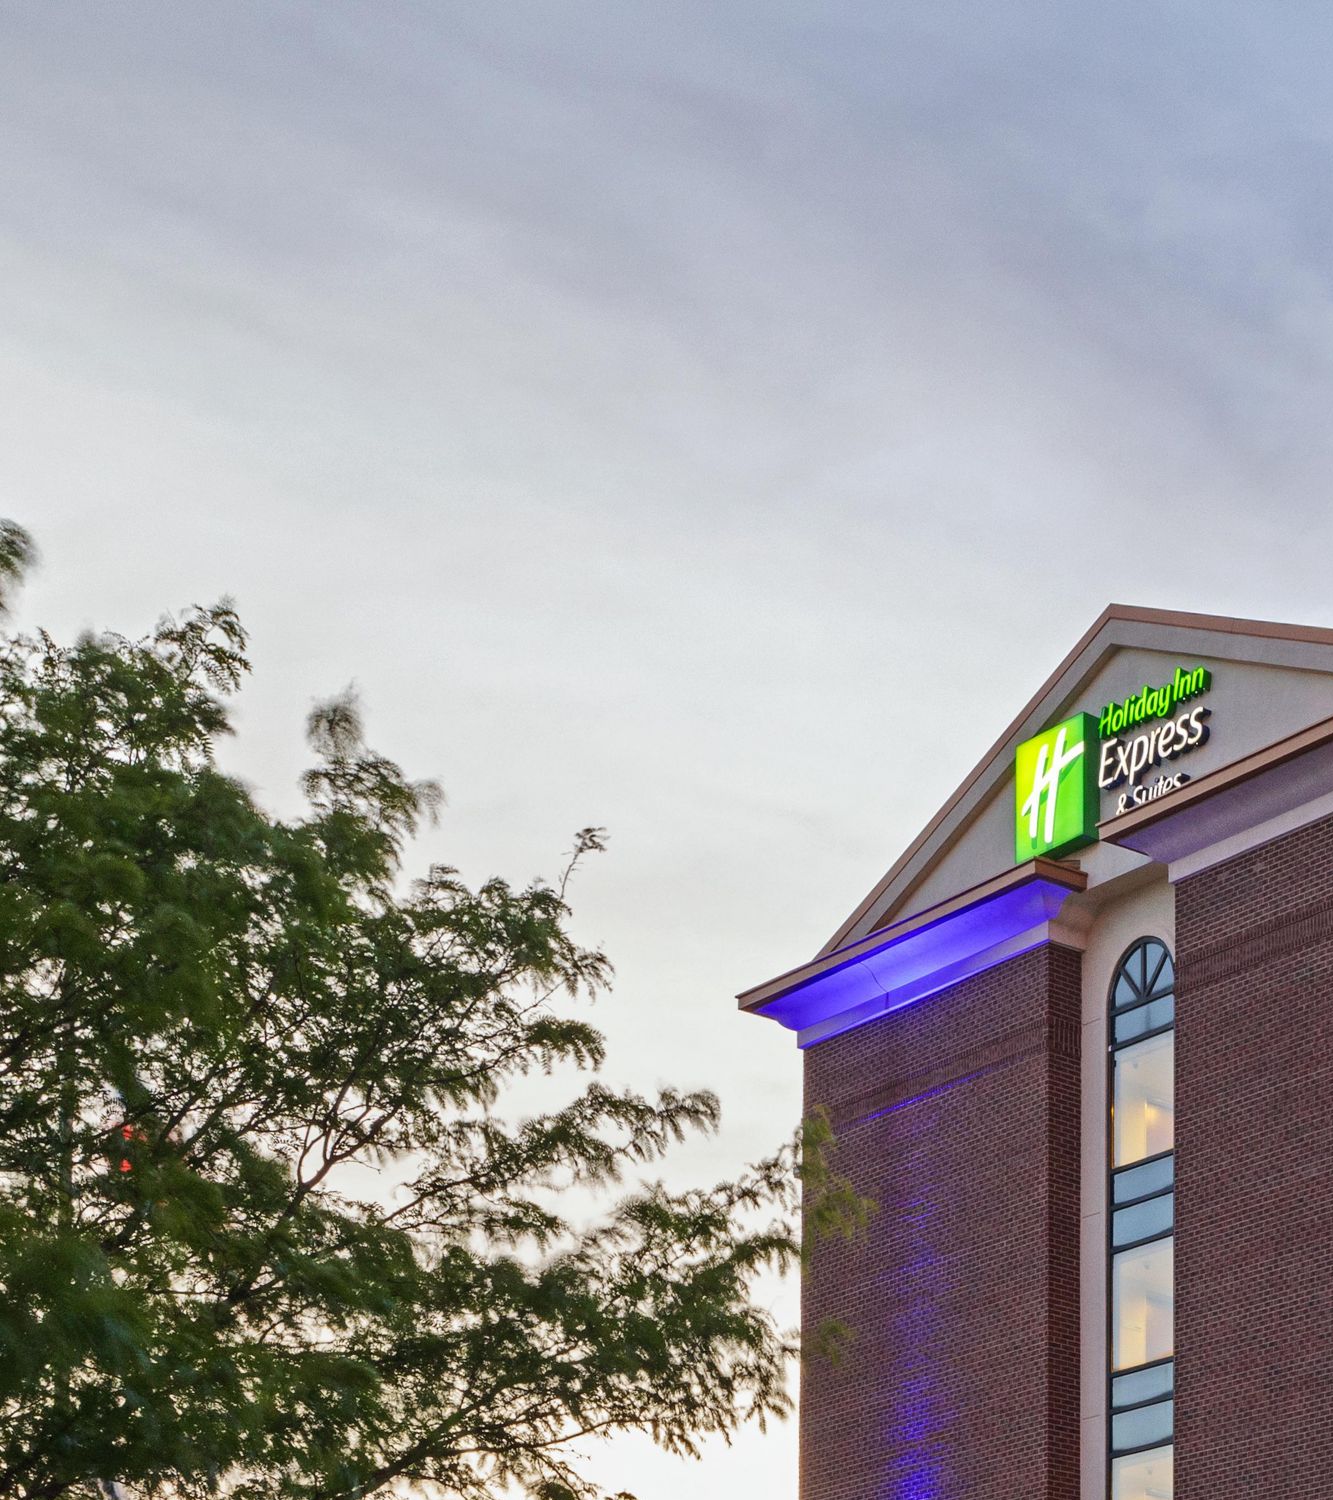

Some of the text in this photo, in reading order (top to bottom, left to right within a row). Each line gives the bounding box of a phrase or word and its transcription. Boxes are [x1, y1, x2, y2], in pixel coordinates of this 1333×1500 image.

[1099, 667, 1205, 738] Holiday Inn
[1098, 706, 1204, 788] Express
[1115, 772, 1182, 816] & Suites
